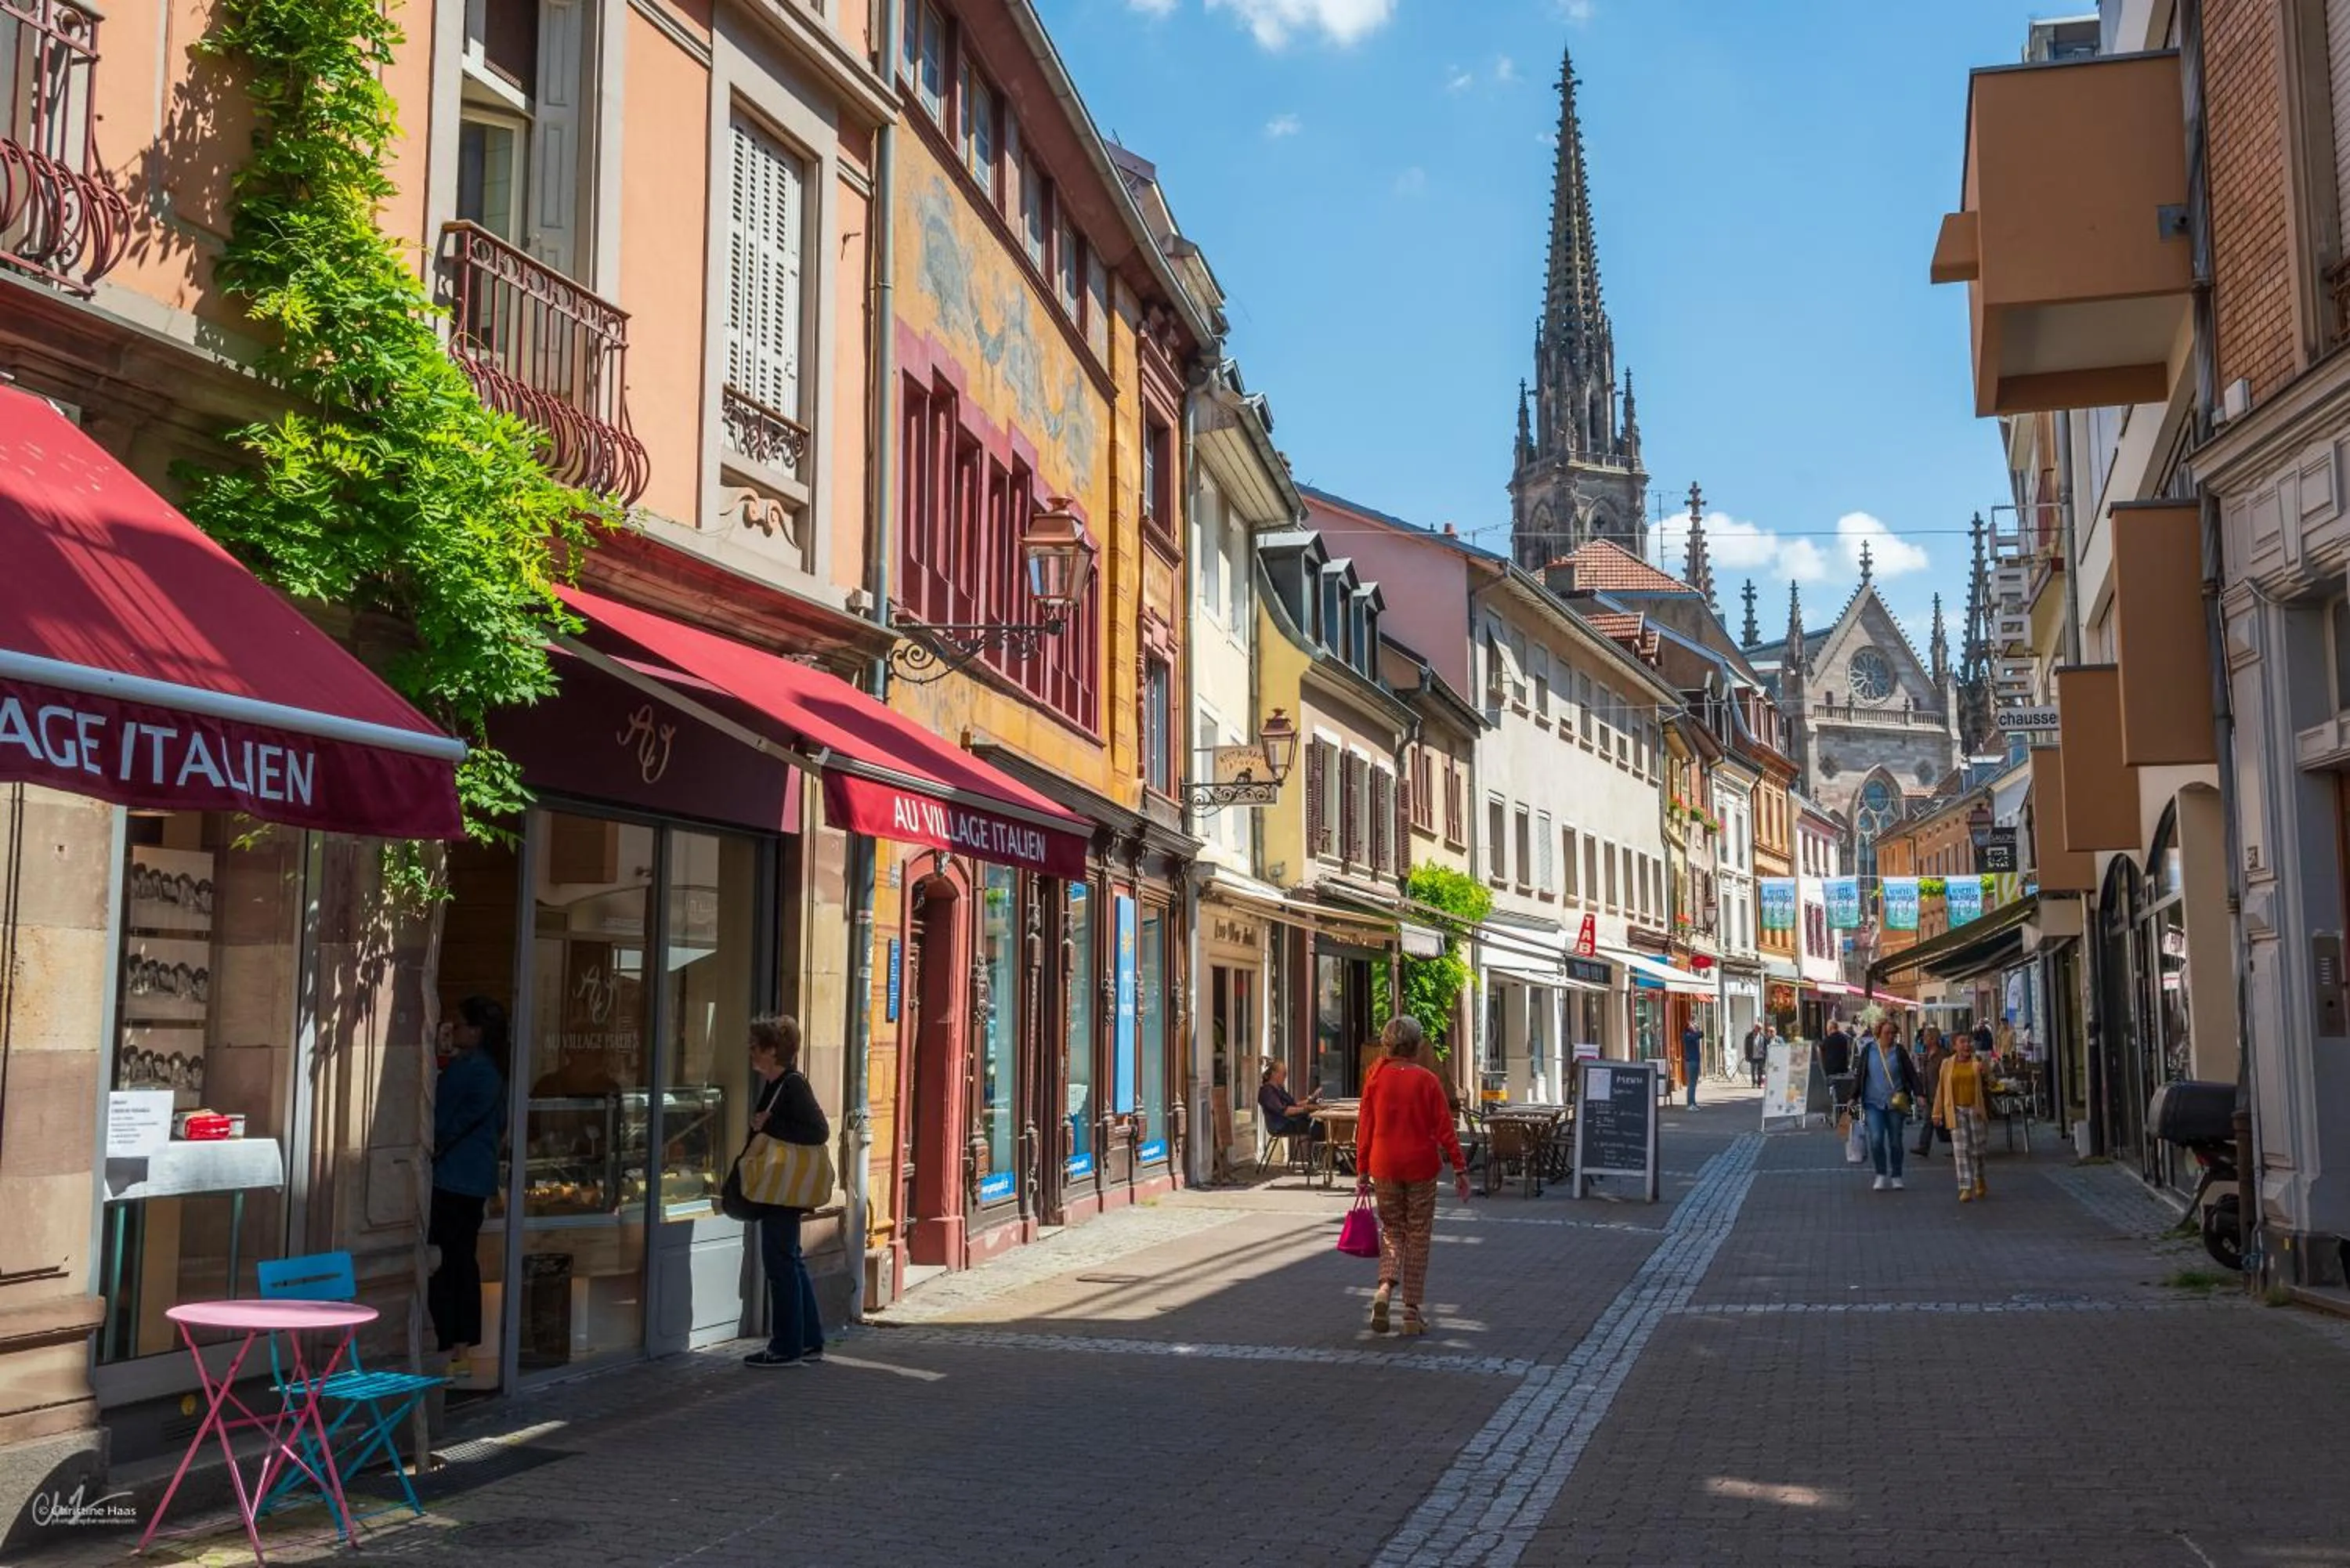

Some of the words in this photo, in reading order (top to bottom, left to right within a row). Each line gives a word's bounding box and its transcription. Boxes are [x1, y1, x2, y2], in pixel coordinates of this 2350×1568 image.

[120, 721, 314, 807] ITALIEN
[895, 795, 919, 833] AU
[921, 801, 989, 850] VILLAGE
[992, 822, 1046, 863] ITALIEN
[1578, 916, 1593, 953] TAB
